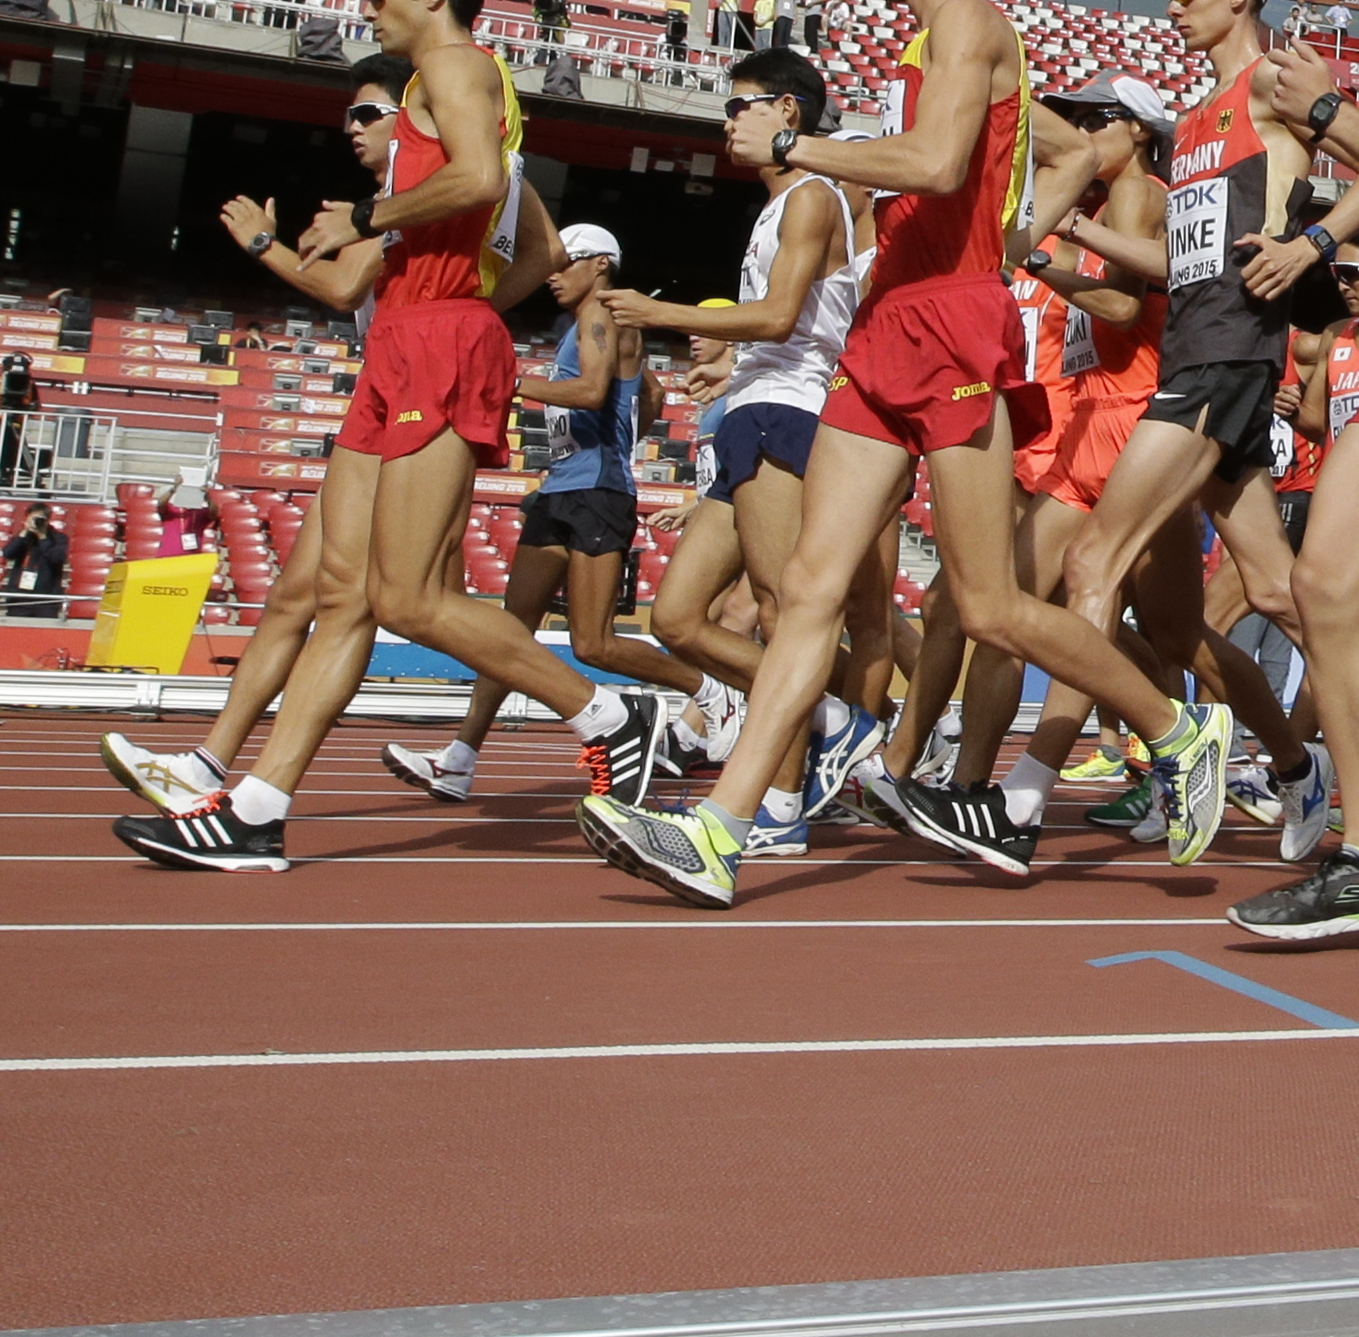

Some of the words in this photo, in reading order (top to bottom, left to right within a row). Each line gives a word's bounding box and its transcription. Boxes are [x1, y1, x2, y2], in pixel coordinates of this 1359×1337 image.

[1173, 182, 1218, 214] TDK
[1170, 219, 1216, 259] INKE
[1192, 259, 1217, 277] 2015
[1065, 311, 1087, 348] ZUKI
[637, 494, 664, 502] EIJING
[142, 585, 189, 597] SEIKO
